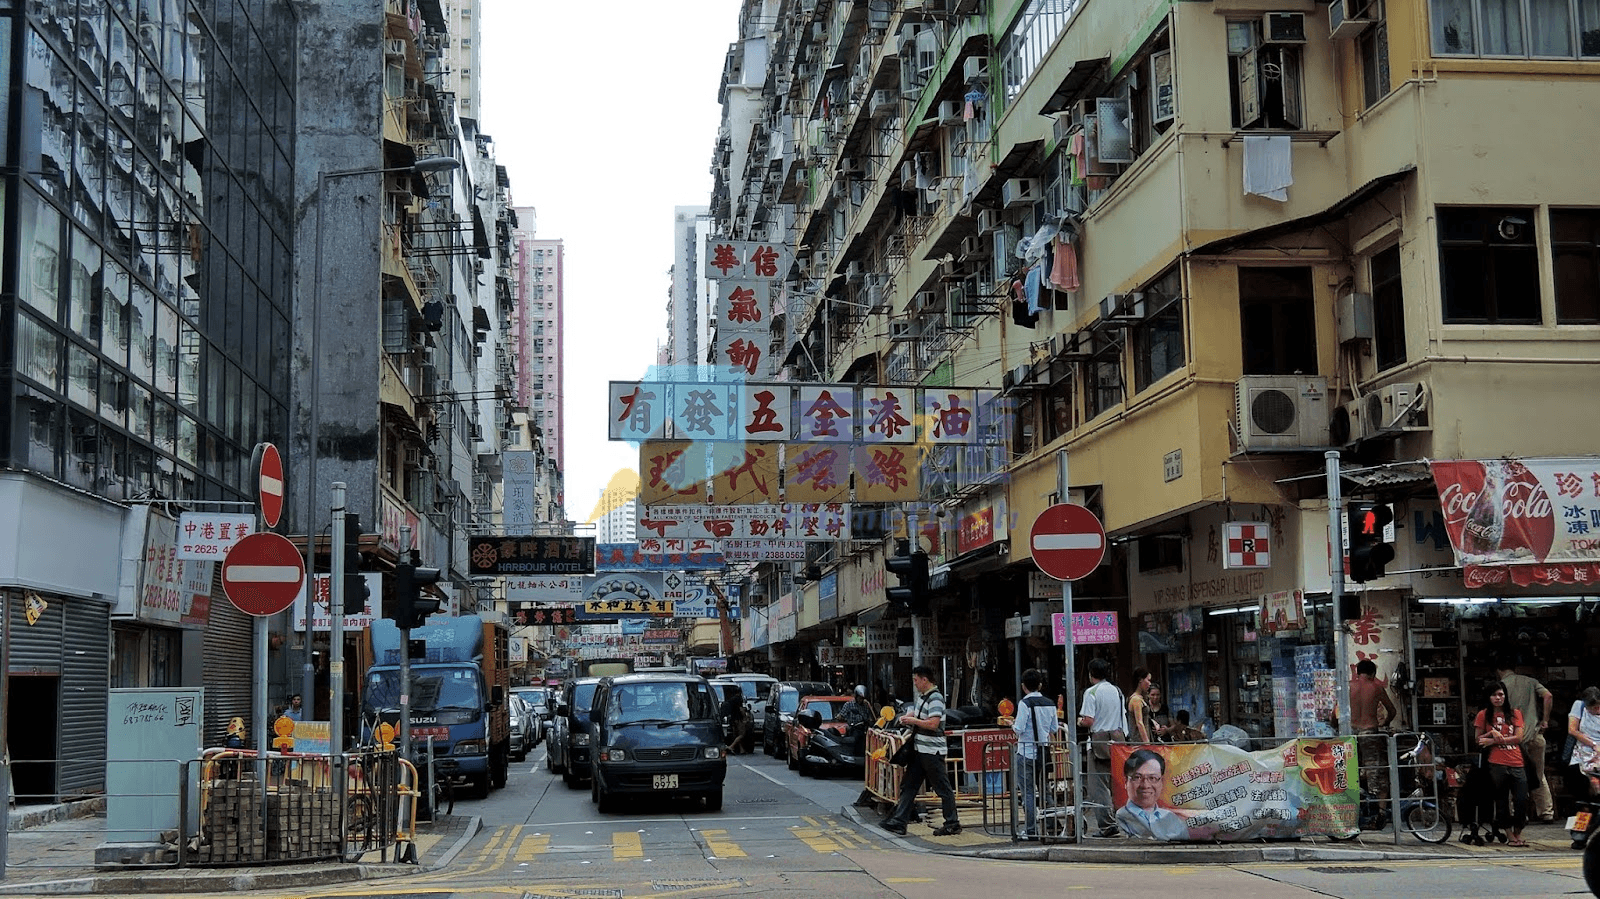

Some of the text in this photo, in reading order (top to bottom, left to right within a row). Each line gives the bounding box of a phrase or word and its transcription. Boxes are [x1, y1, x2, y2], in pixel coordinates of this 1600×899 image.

[184, 520, 249, 540] 中港置業
[1570, 539, 1600, 550] TOK
[195, 545, 218, 554] 2625
[765, 551, 784, 559] 2388
[786, 551, 805, 559] 0562
[498, 562, 585, 572] HARBOUR HOTEL
[410, 716, 436, 724] SUZU
[654, 781, 677, 789] 9973
